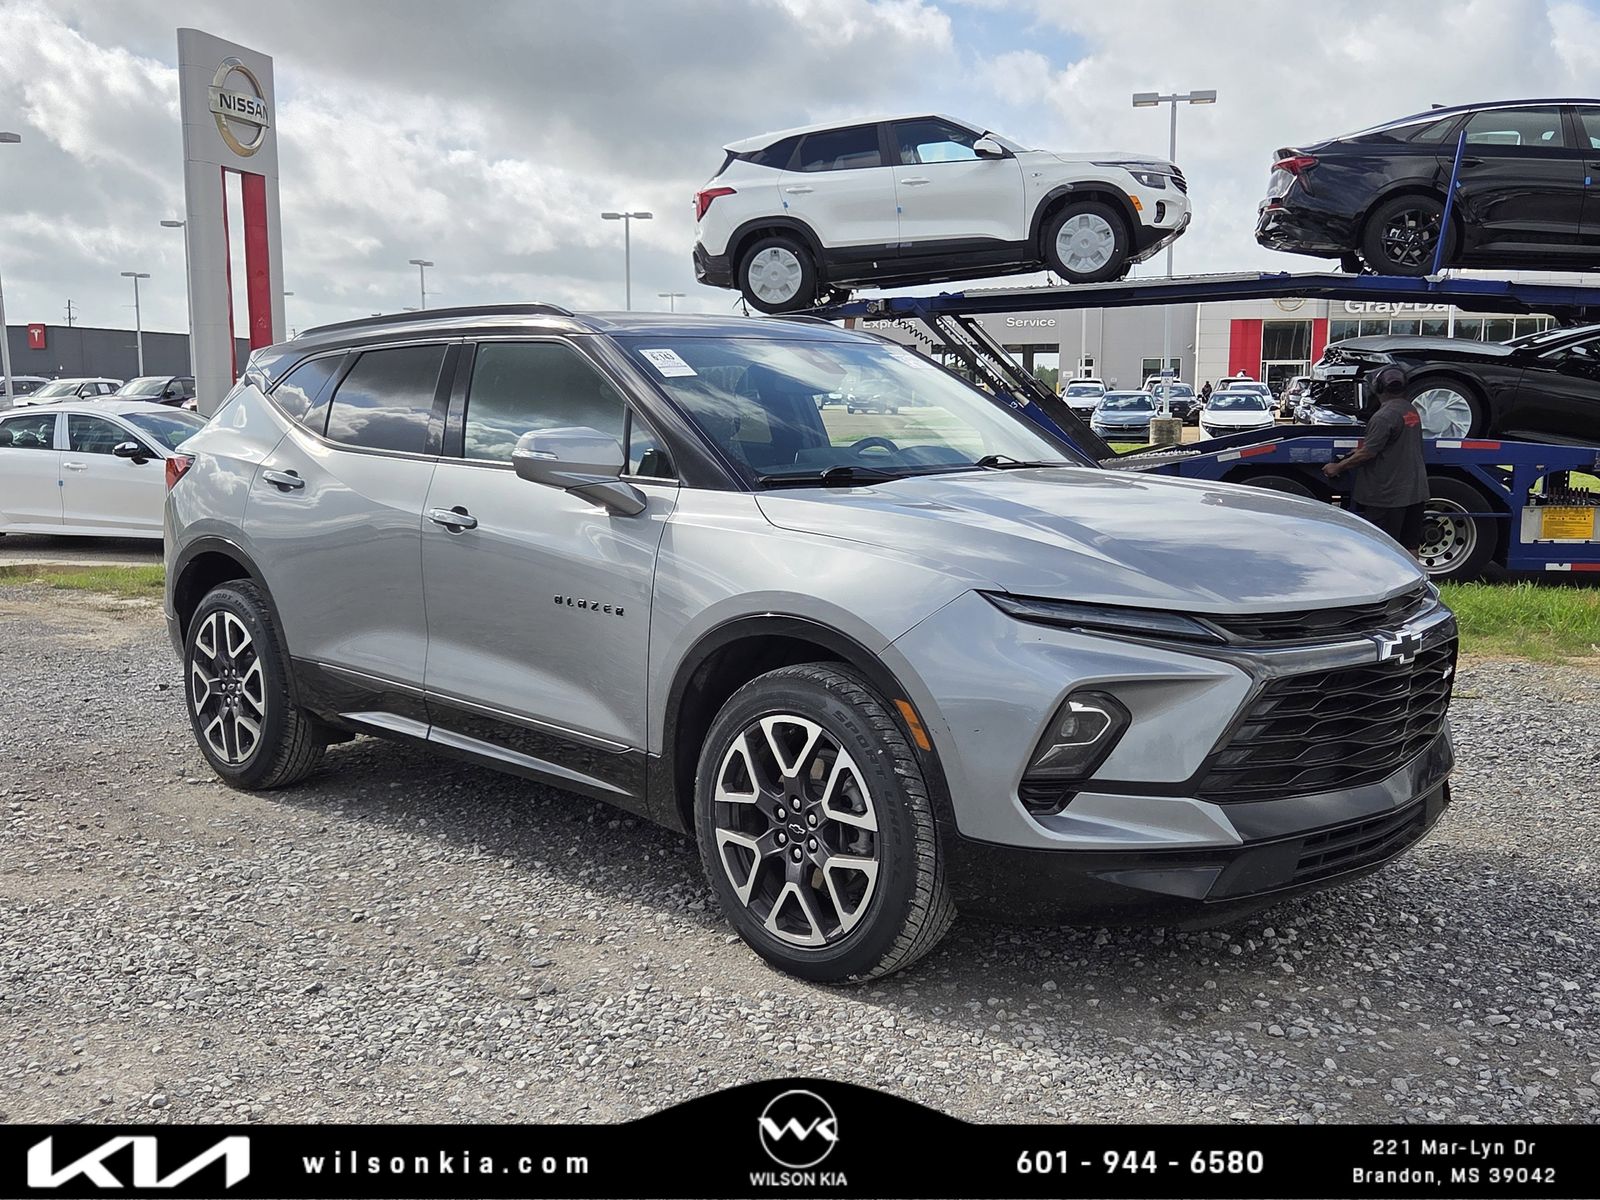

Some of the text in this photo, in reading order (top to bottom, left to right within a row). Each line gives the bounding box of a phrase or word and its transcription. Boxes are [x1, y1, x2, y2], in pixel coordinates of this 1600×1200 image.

[219, 93, 269, 120] NISSAN
[1006, 316, 1056, 328] Service
[553, 594, 624, 616] BLAZER
[832, 710, 888, 780] SPORT
